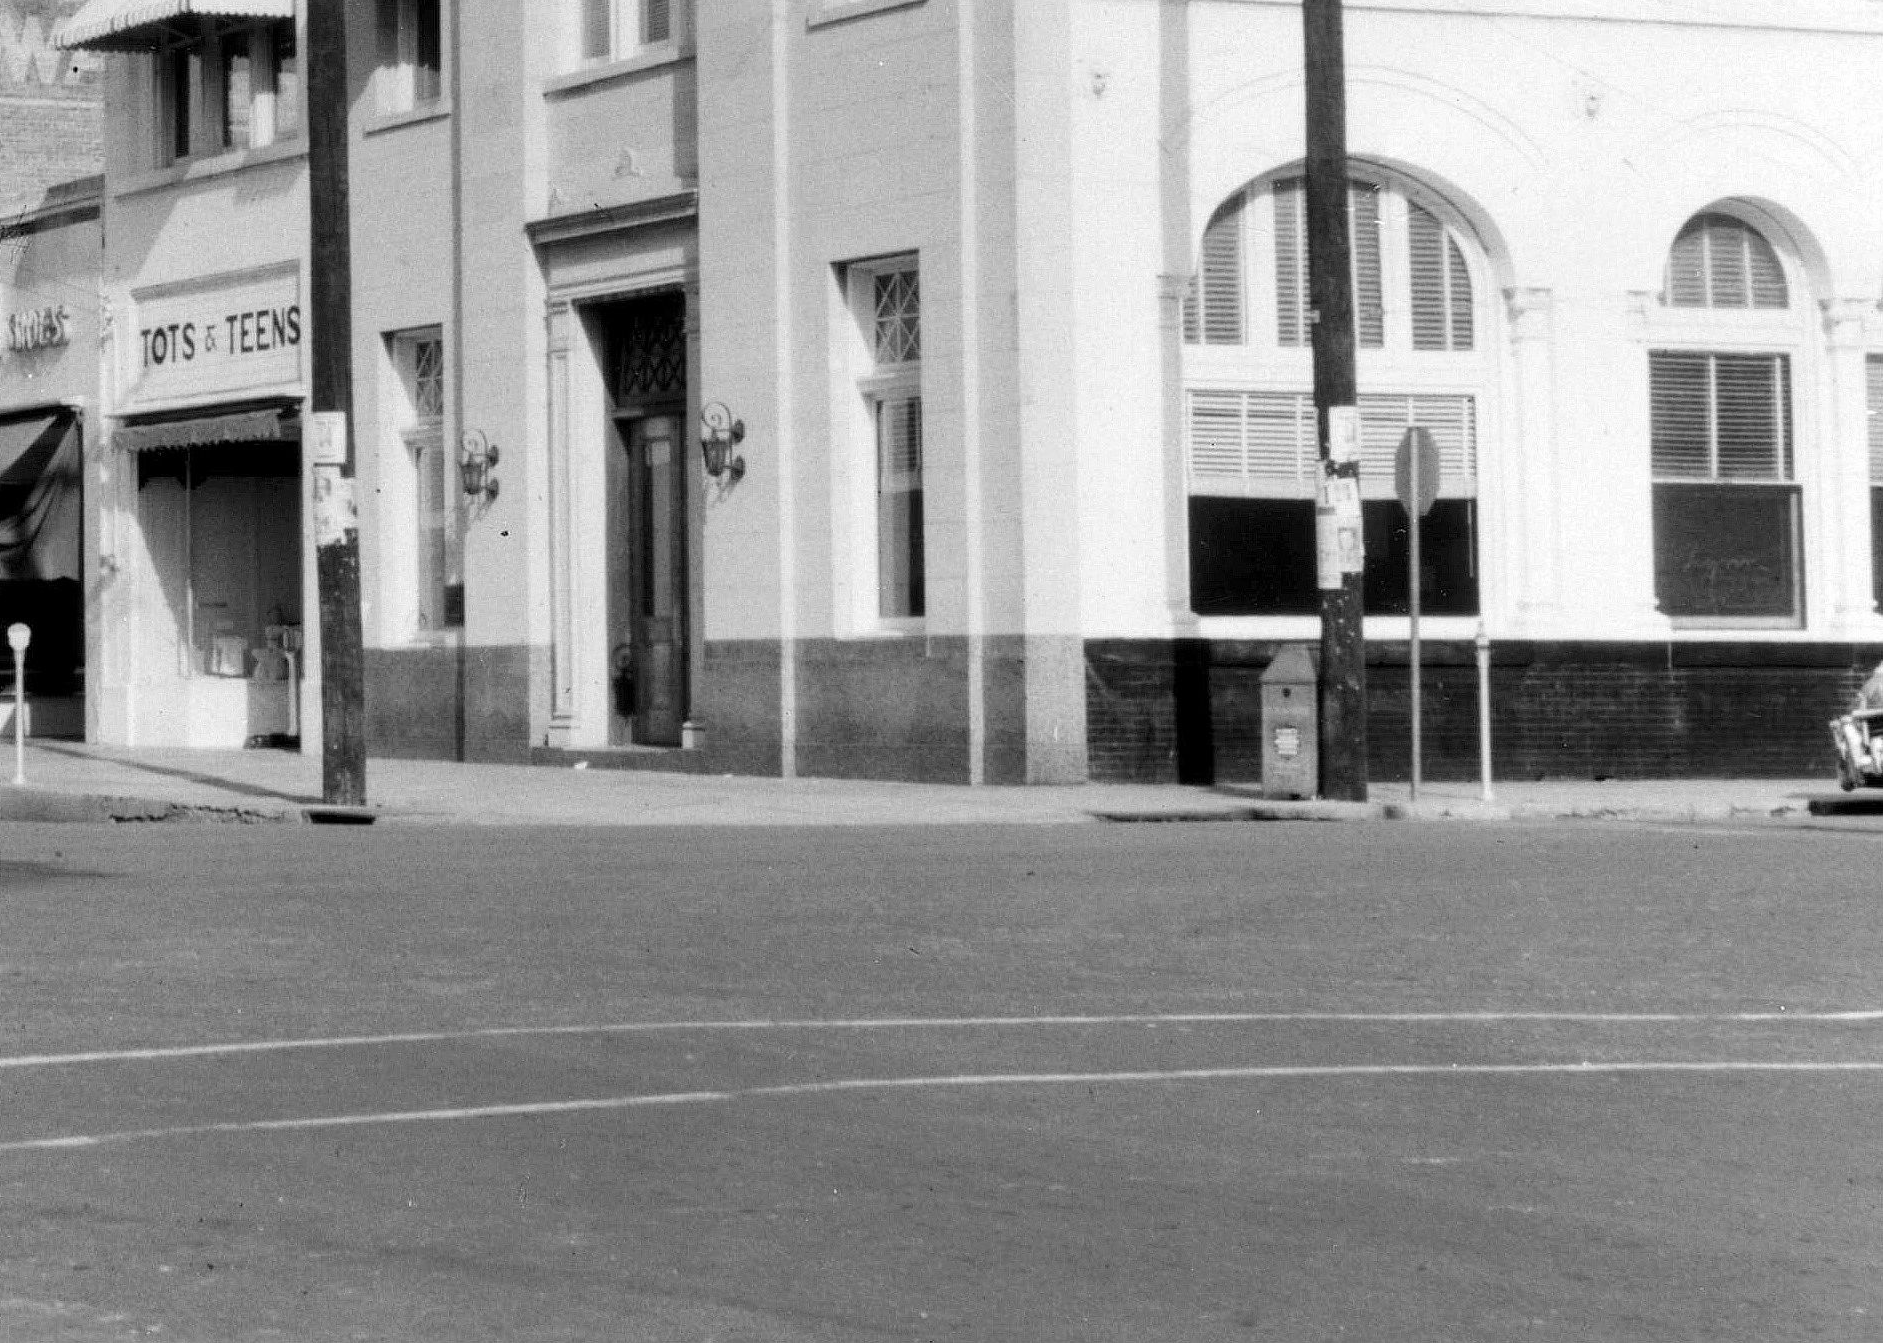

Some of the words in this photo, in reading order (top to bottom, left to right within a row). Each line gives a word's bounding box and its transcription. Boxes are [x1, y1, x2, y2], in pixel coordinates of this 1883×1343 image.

[140, 322, 195, 368] TOTS
[204, 326, 218, 352] &
[226, 305, 302, 357] TEENS
